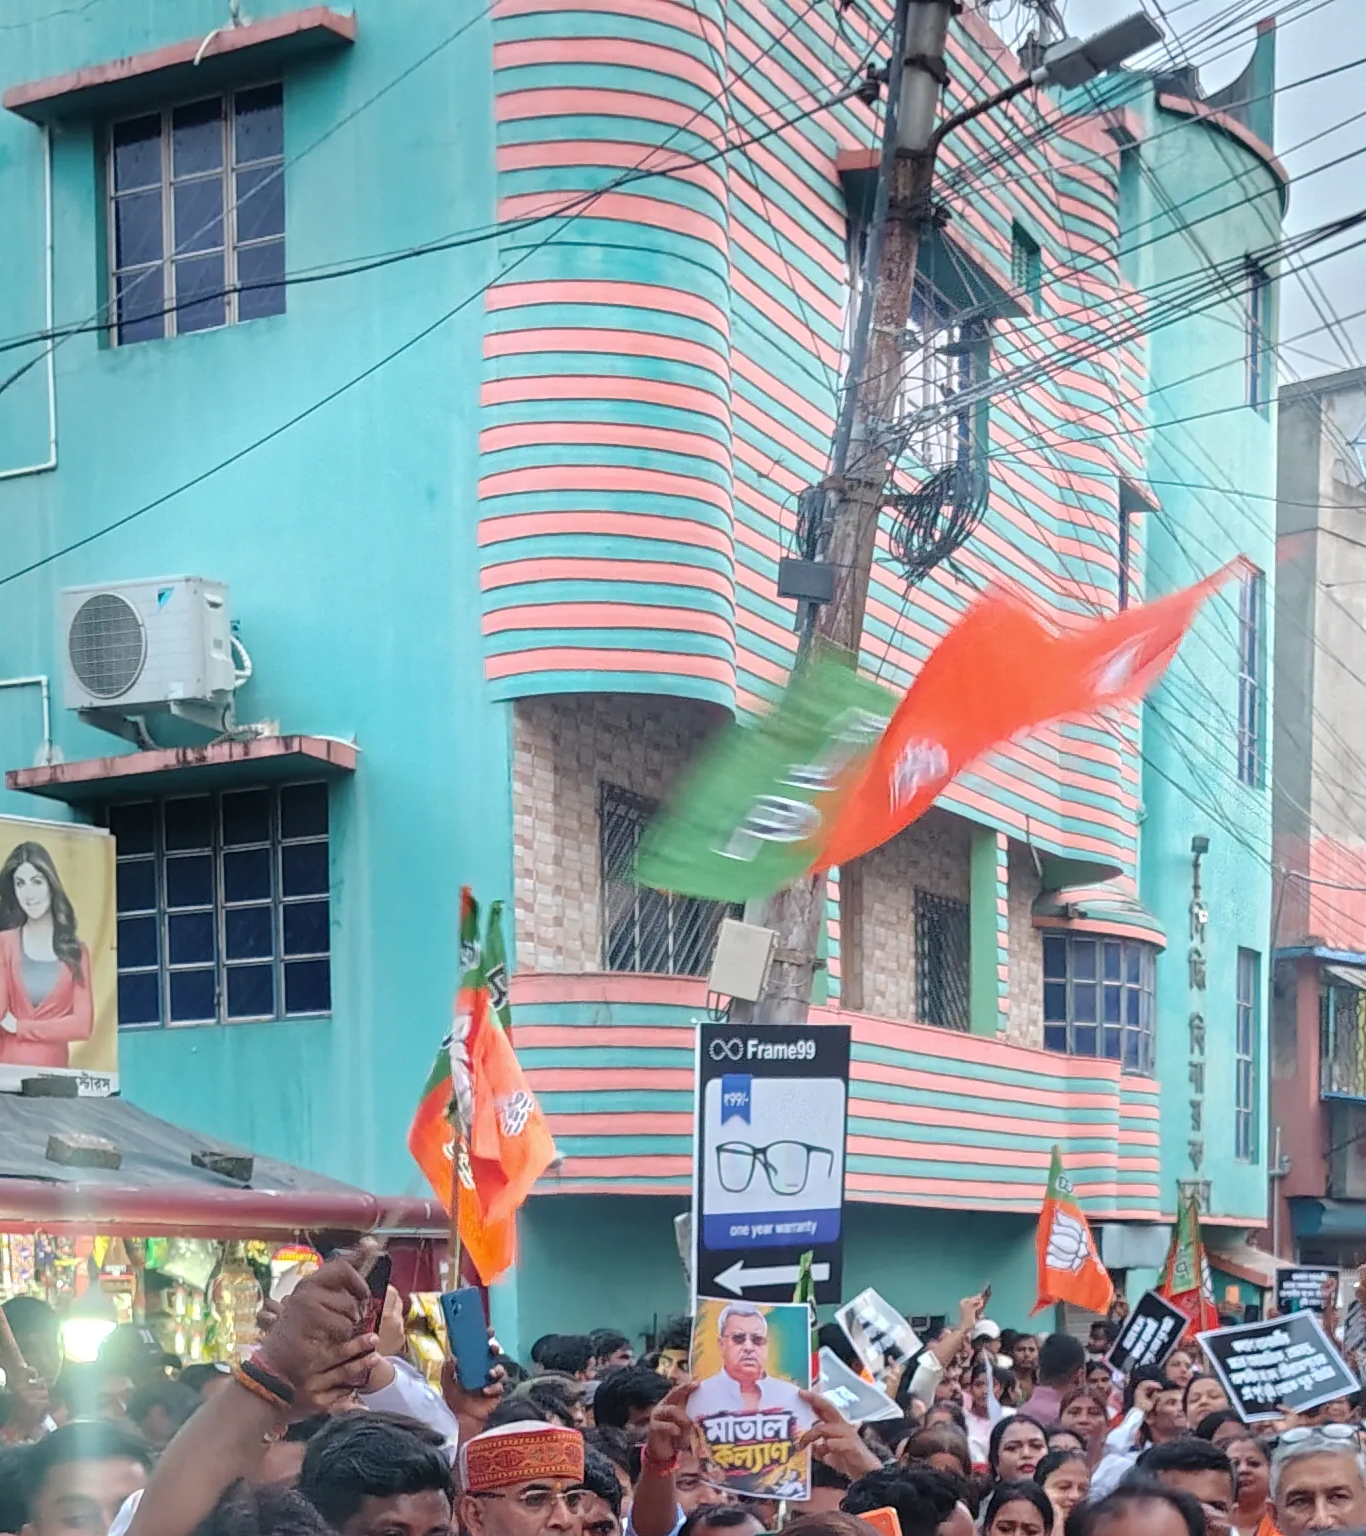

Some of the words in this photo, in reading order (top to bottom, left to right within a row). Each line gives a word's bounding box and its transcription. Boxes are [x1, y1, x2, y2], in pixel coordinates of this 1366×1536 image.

[746, 1039, 816, 1060] Frame99
[729, 1225, 750, 1237] one
[751, 1223, 774, 1239] year
[775, 1220, 817, 1236] warranty
[703, 1413, 792, 1442] মাতাল
[712, 1441, 792, 1473] কল্যাণ
